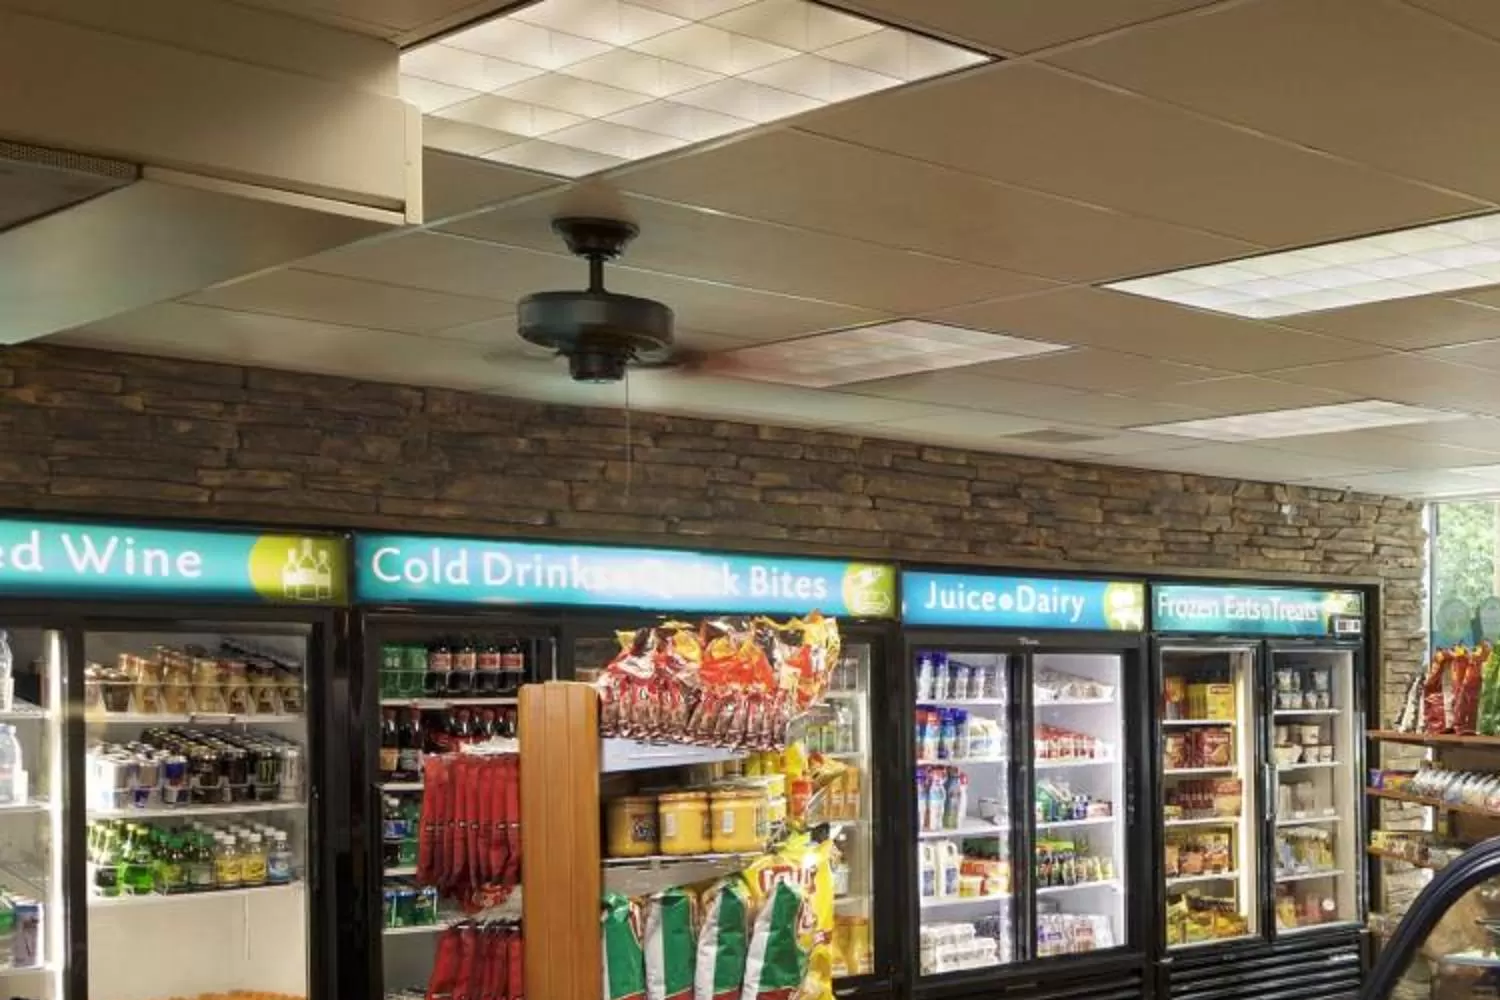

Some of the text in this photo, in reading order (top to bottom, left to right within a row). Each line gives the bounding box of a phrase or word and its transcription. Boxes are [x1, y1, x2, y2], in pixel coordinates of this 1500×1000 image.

[0, 529, 203, 578] d Wine
[371, 547, 470, 585] Cold
[750, 564, 829, 599] Bites
